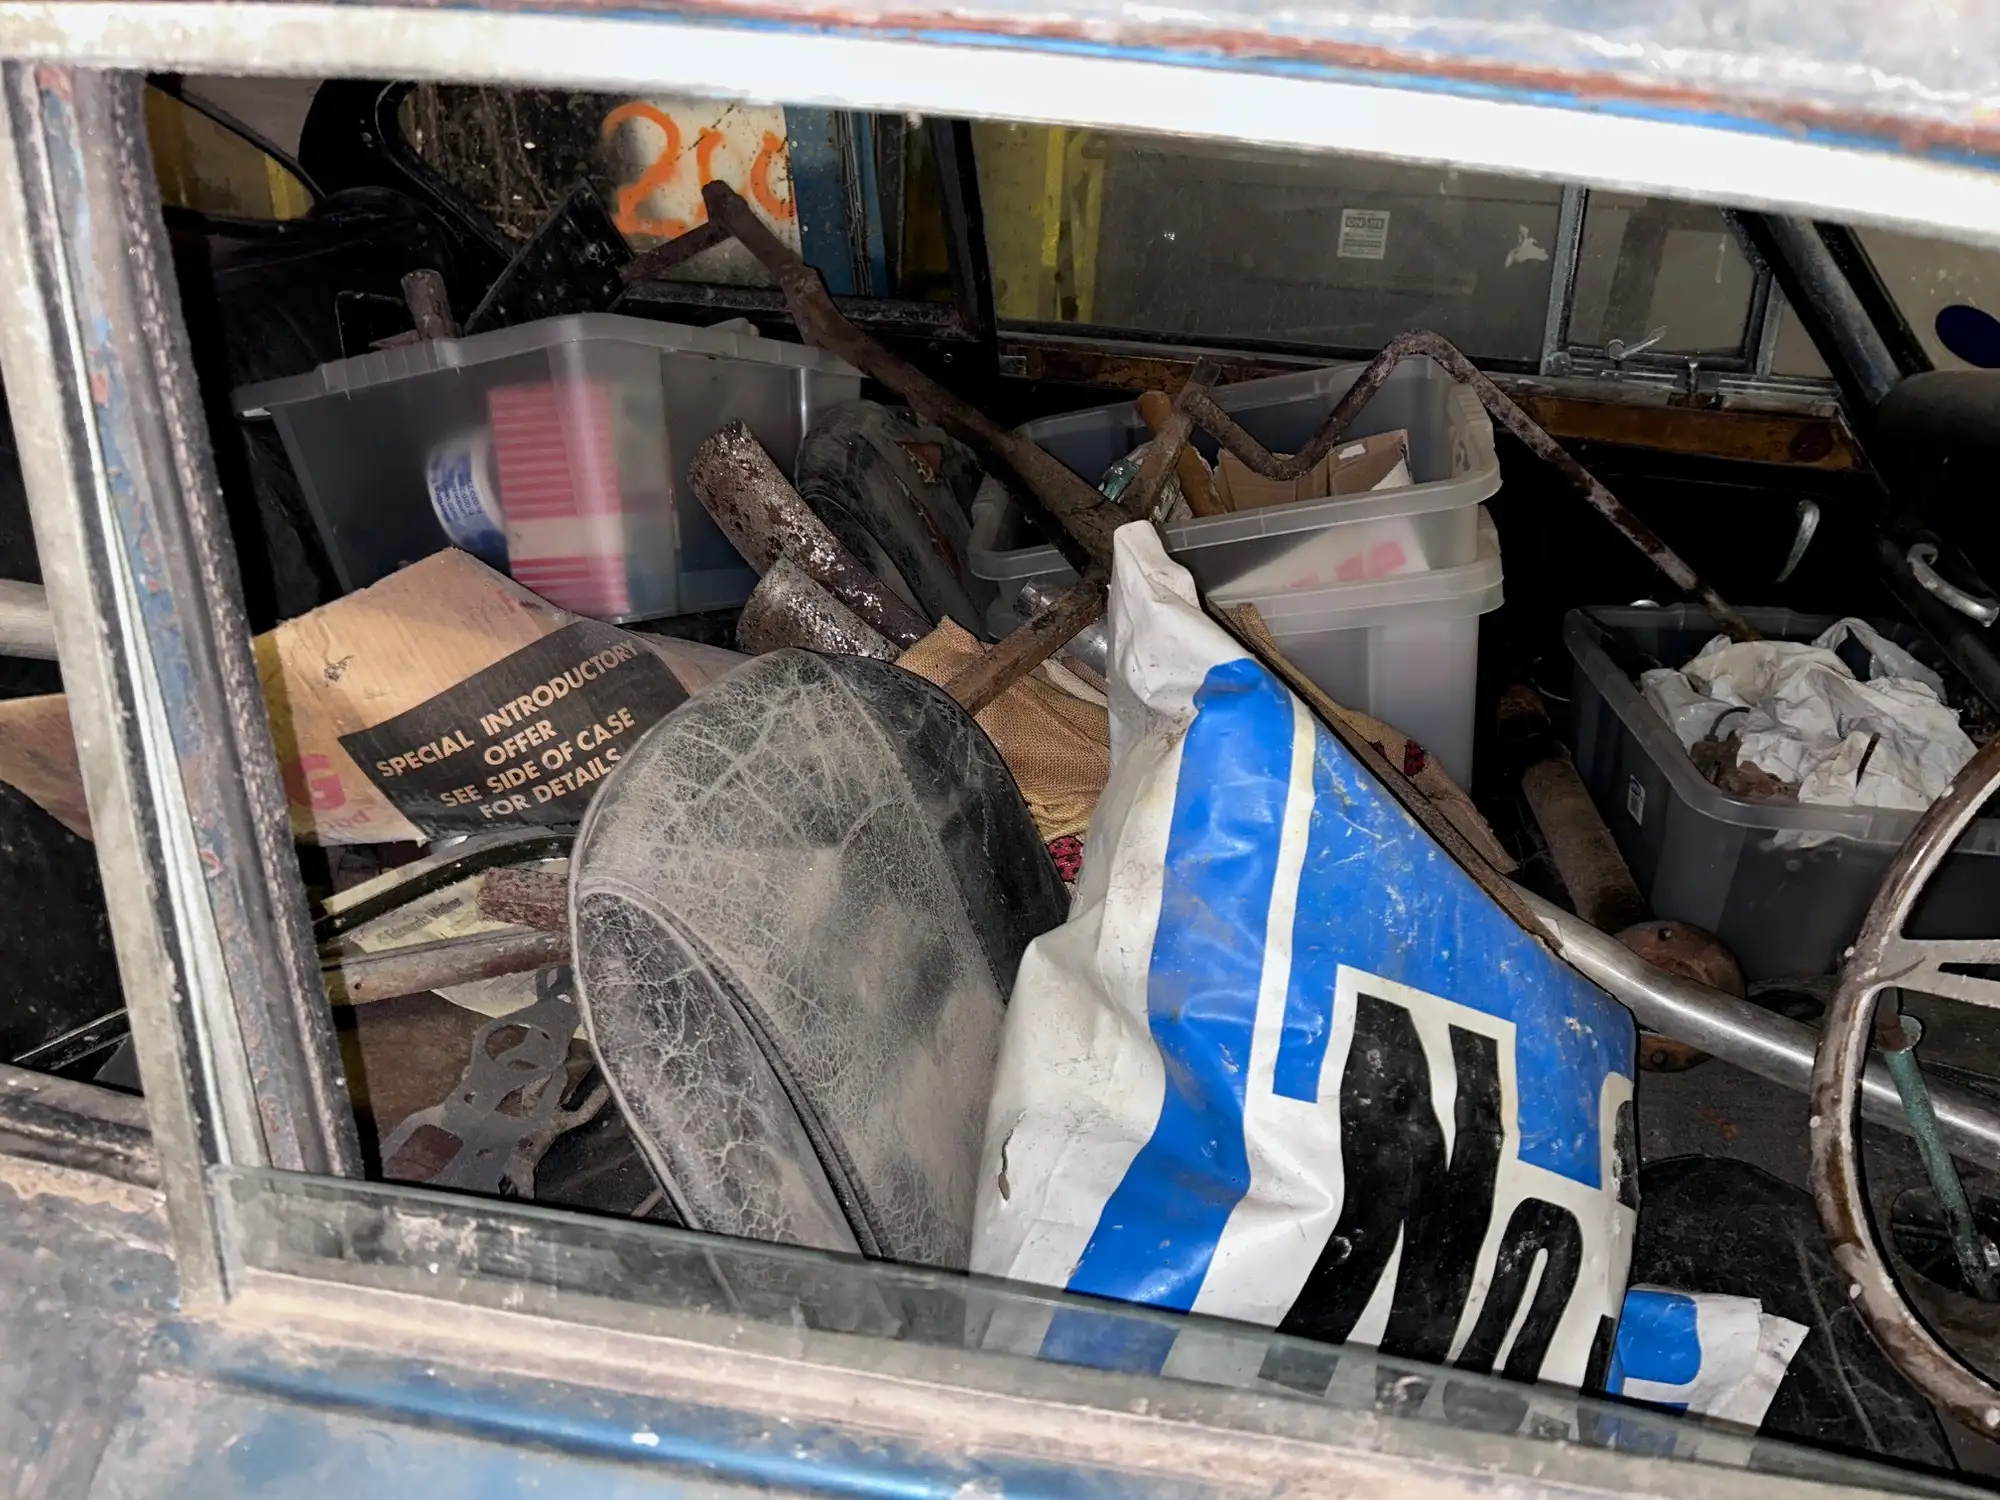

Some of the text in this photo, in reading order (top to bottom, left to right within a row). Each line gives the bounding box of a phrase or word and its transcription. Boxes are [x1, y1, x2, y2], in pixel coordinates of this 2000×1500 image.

[376, 640, 640, 778] SPECIAL INTRODUCTORY
[484, 719, 557, 766] OFFER
[439, 707, 636, 808] SEE SIDE OF CASE
[478, 747, 622, 820] FOR DETAILS
